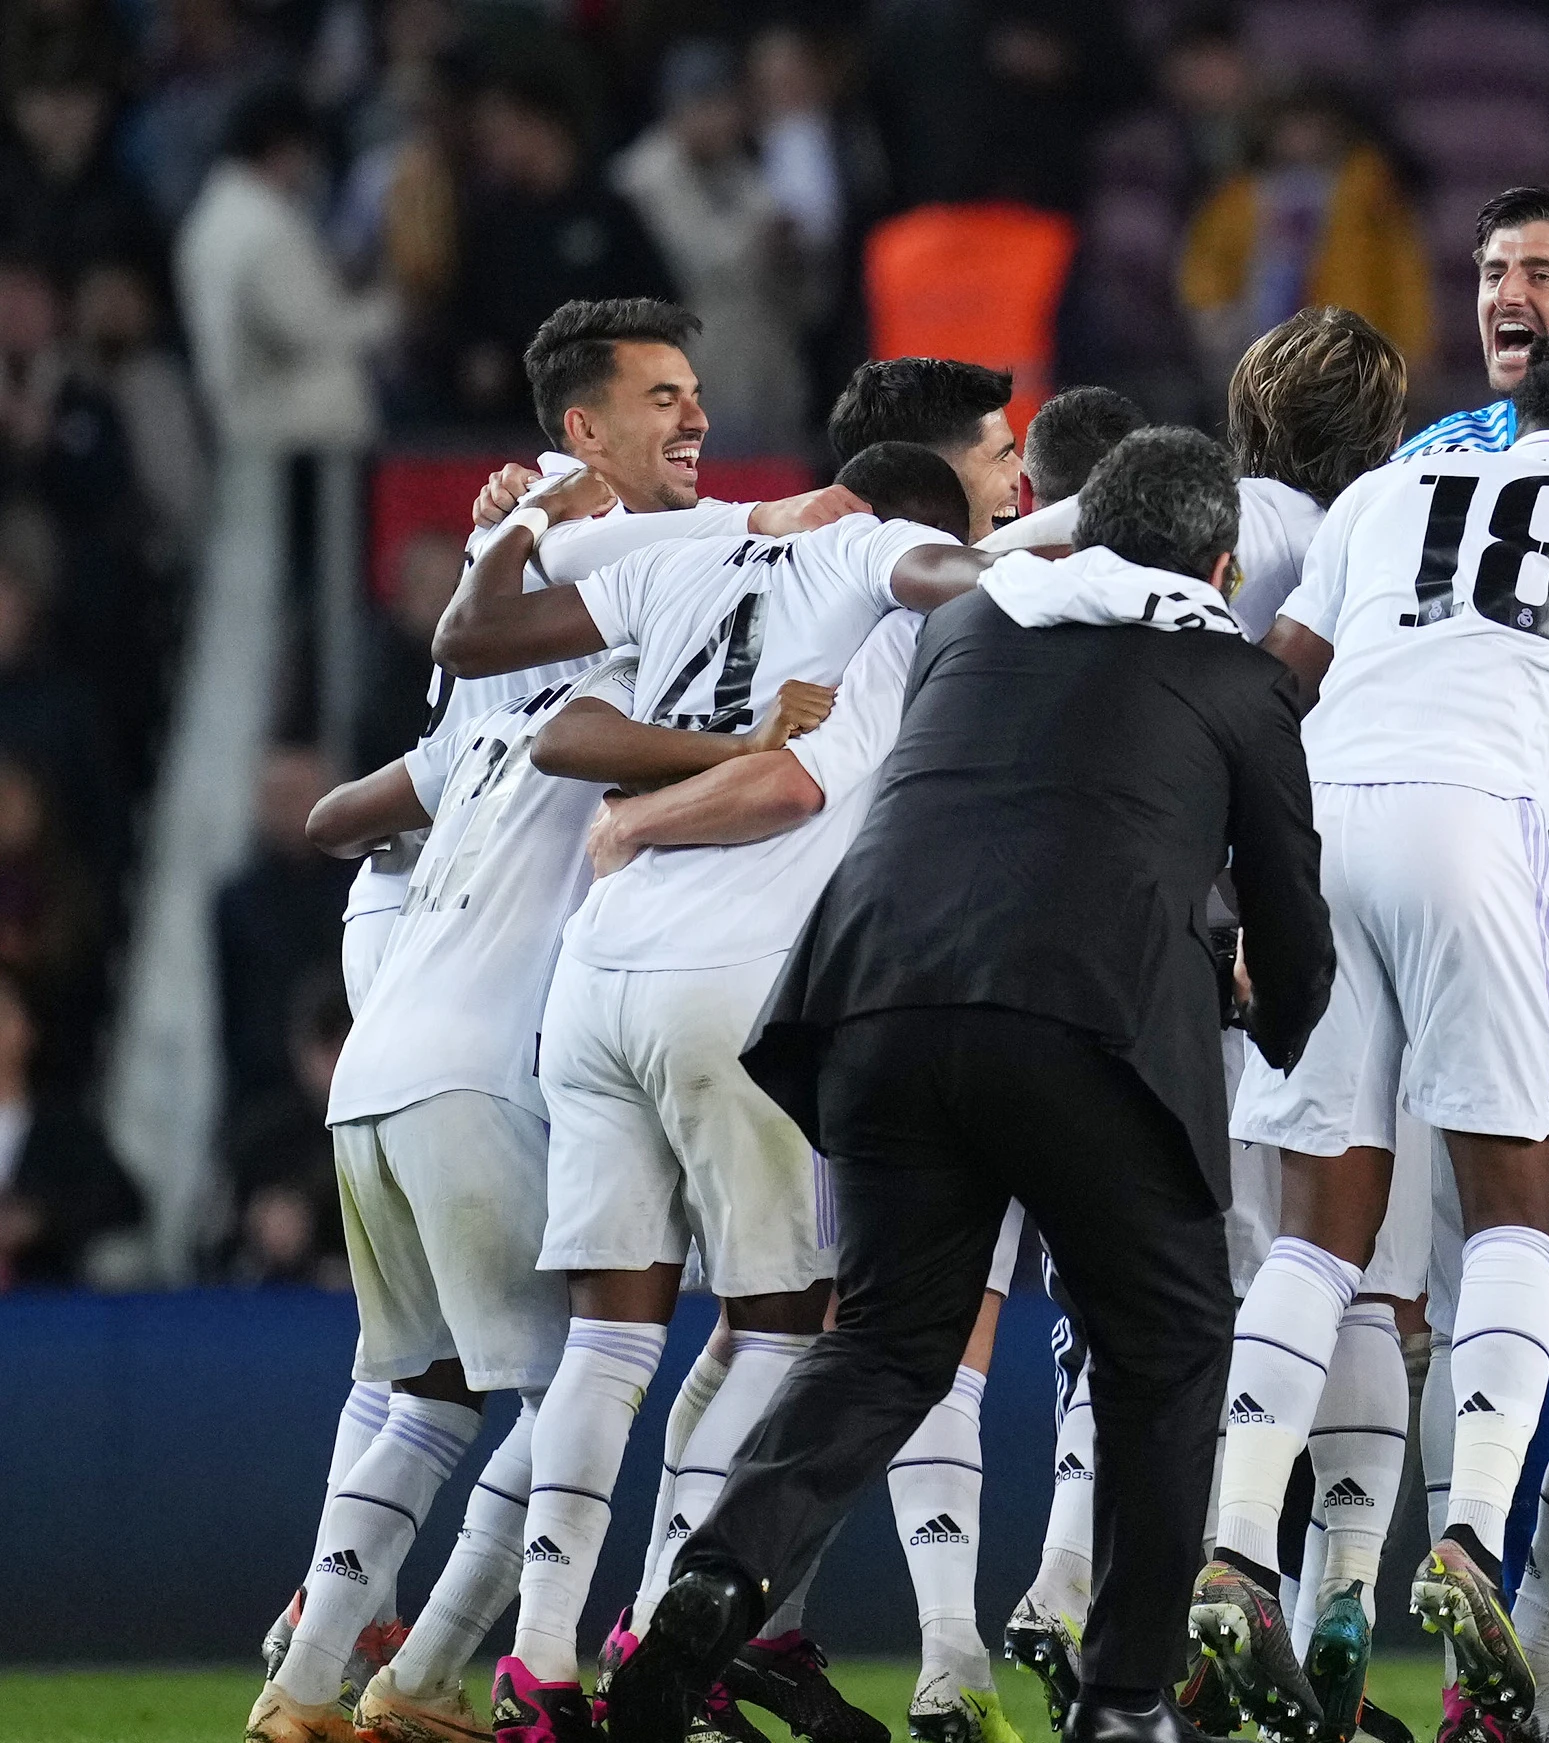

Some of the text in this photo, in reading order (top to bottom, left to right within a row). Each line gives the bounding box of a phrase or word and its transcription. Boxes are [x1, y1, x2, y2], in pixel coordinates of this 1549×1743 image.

[1324, 1493, 1375, 1508] adidas
[909, 1532, 969, 1546] adidas
[316, 1562, 369, 1585] adidas
